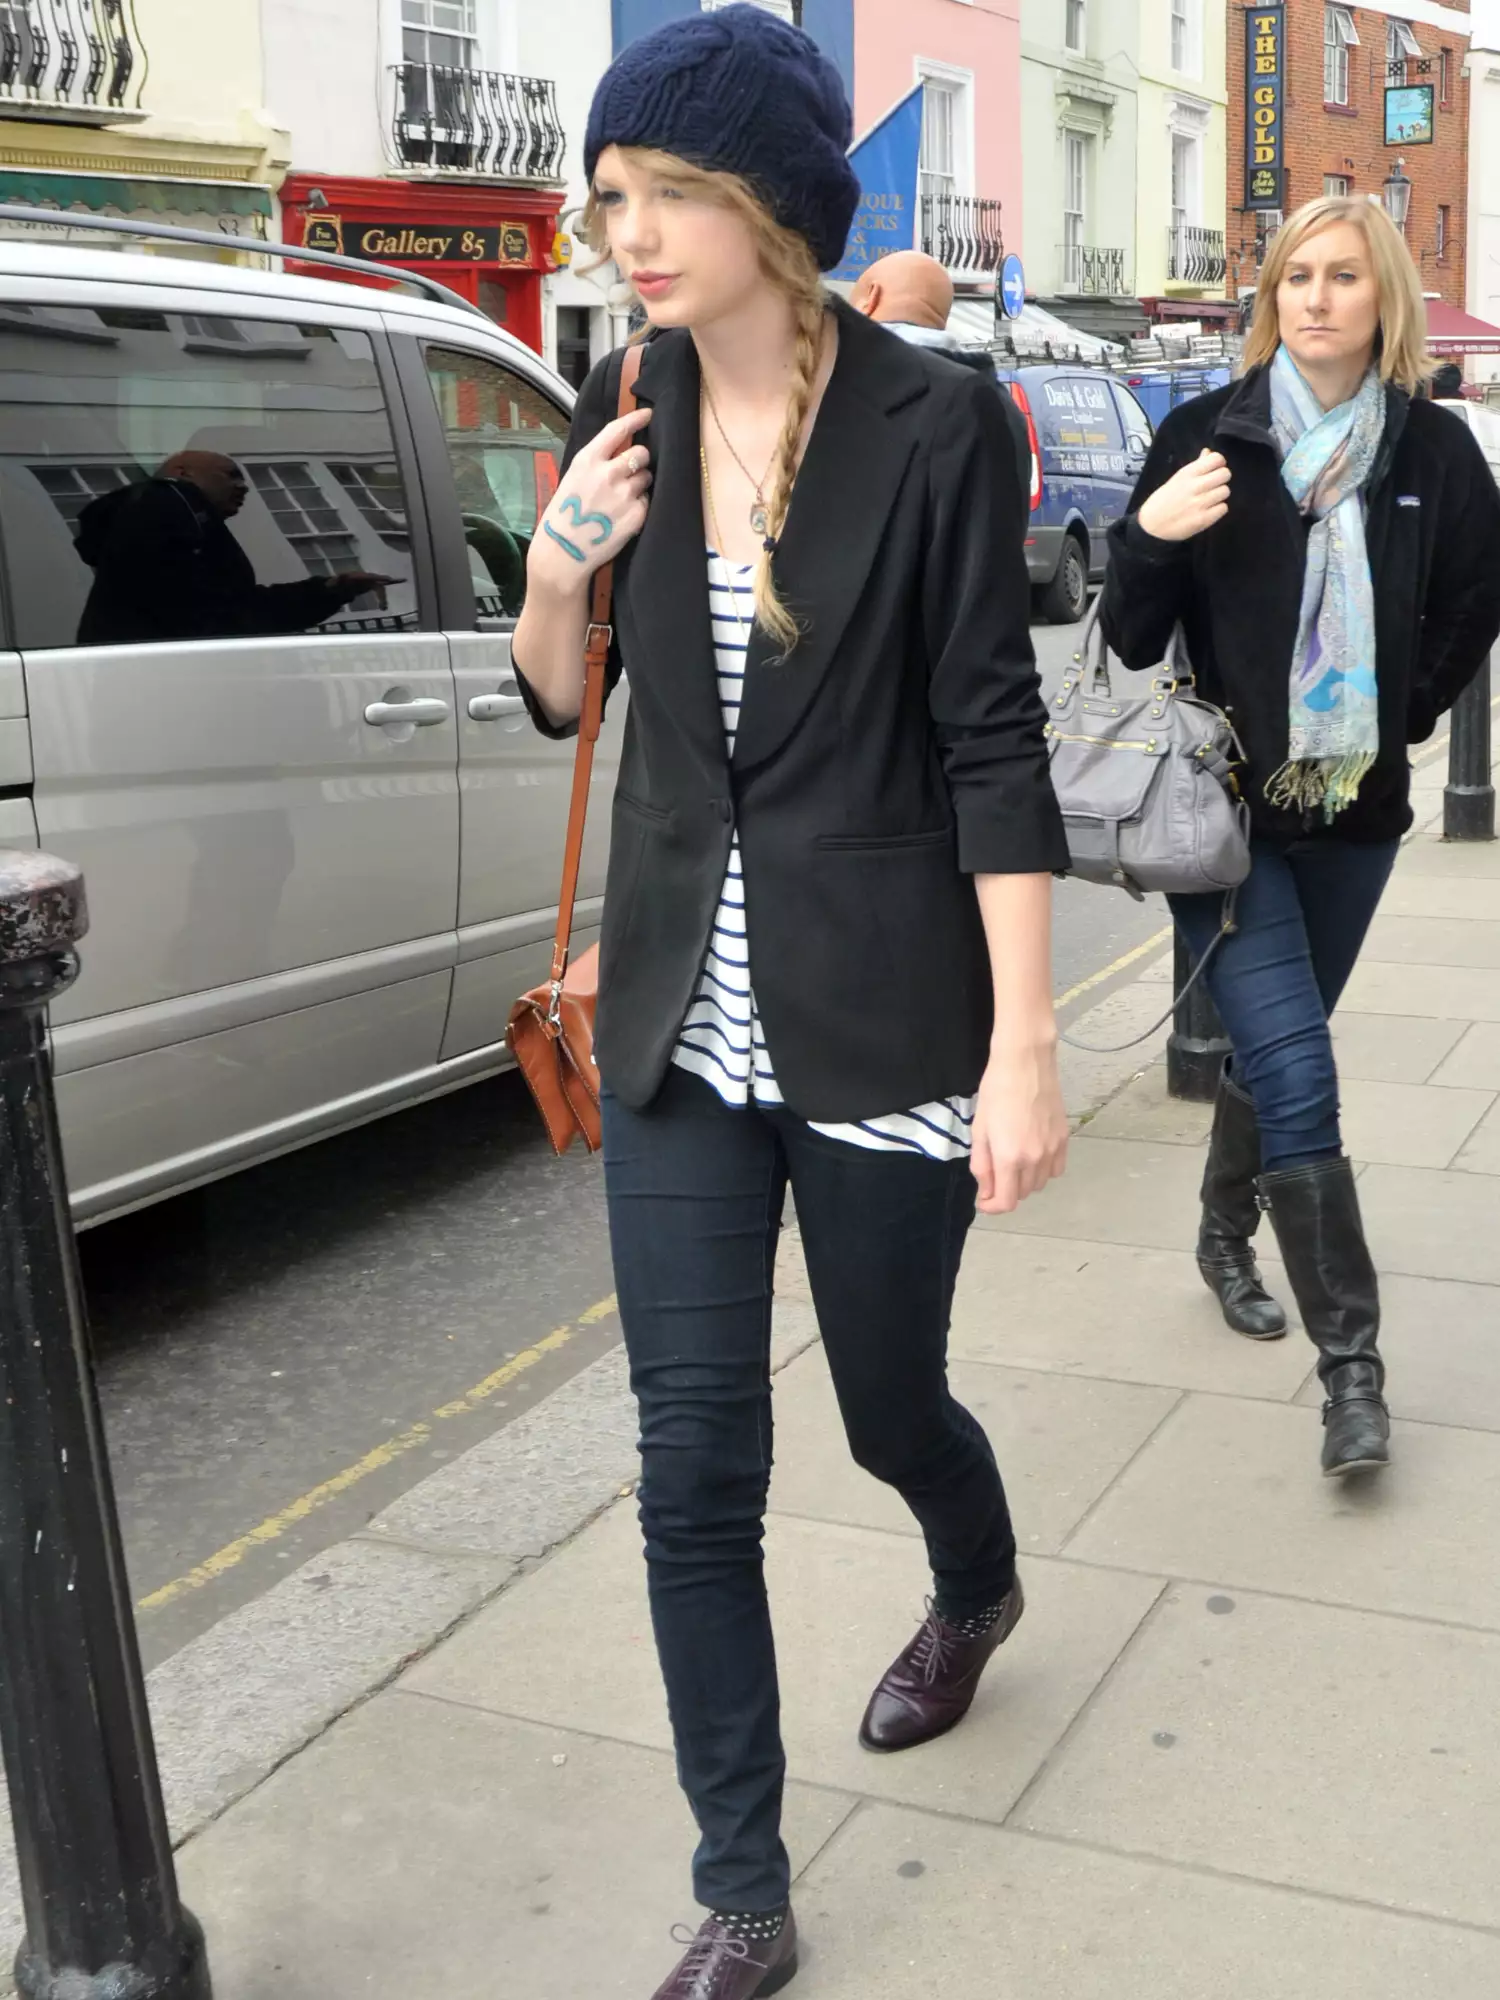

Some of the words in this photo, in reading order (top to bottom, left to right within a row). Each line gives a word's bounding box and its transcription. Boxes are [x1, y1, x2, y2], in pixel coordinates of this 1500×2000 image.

[1254, 16, 1277, 74] THE
[1254, 87, 1276, 164] GOLD
[858, 193, 904, 212] IQUE
[853, 214, 898, 231] OCKS
[361, 229, 452, 261] Gallery
[460, 231, 486, 261] 85
[1073, 385, 1086, 408] &
[544, 495, 613, 561] 13
